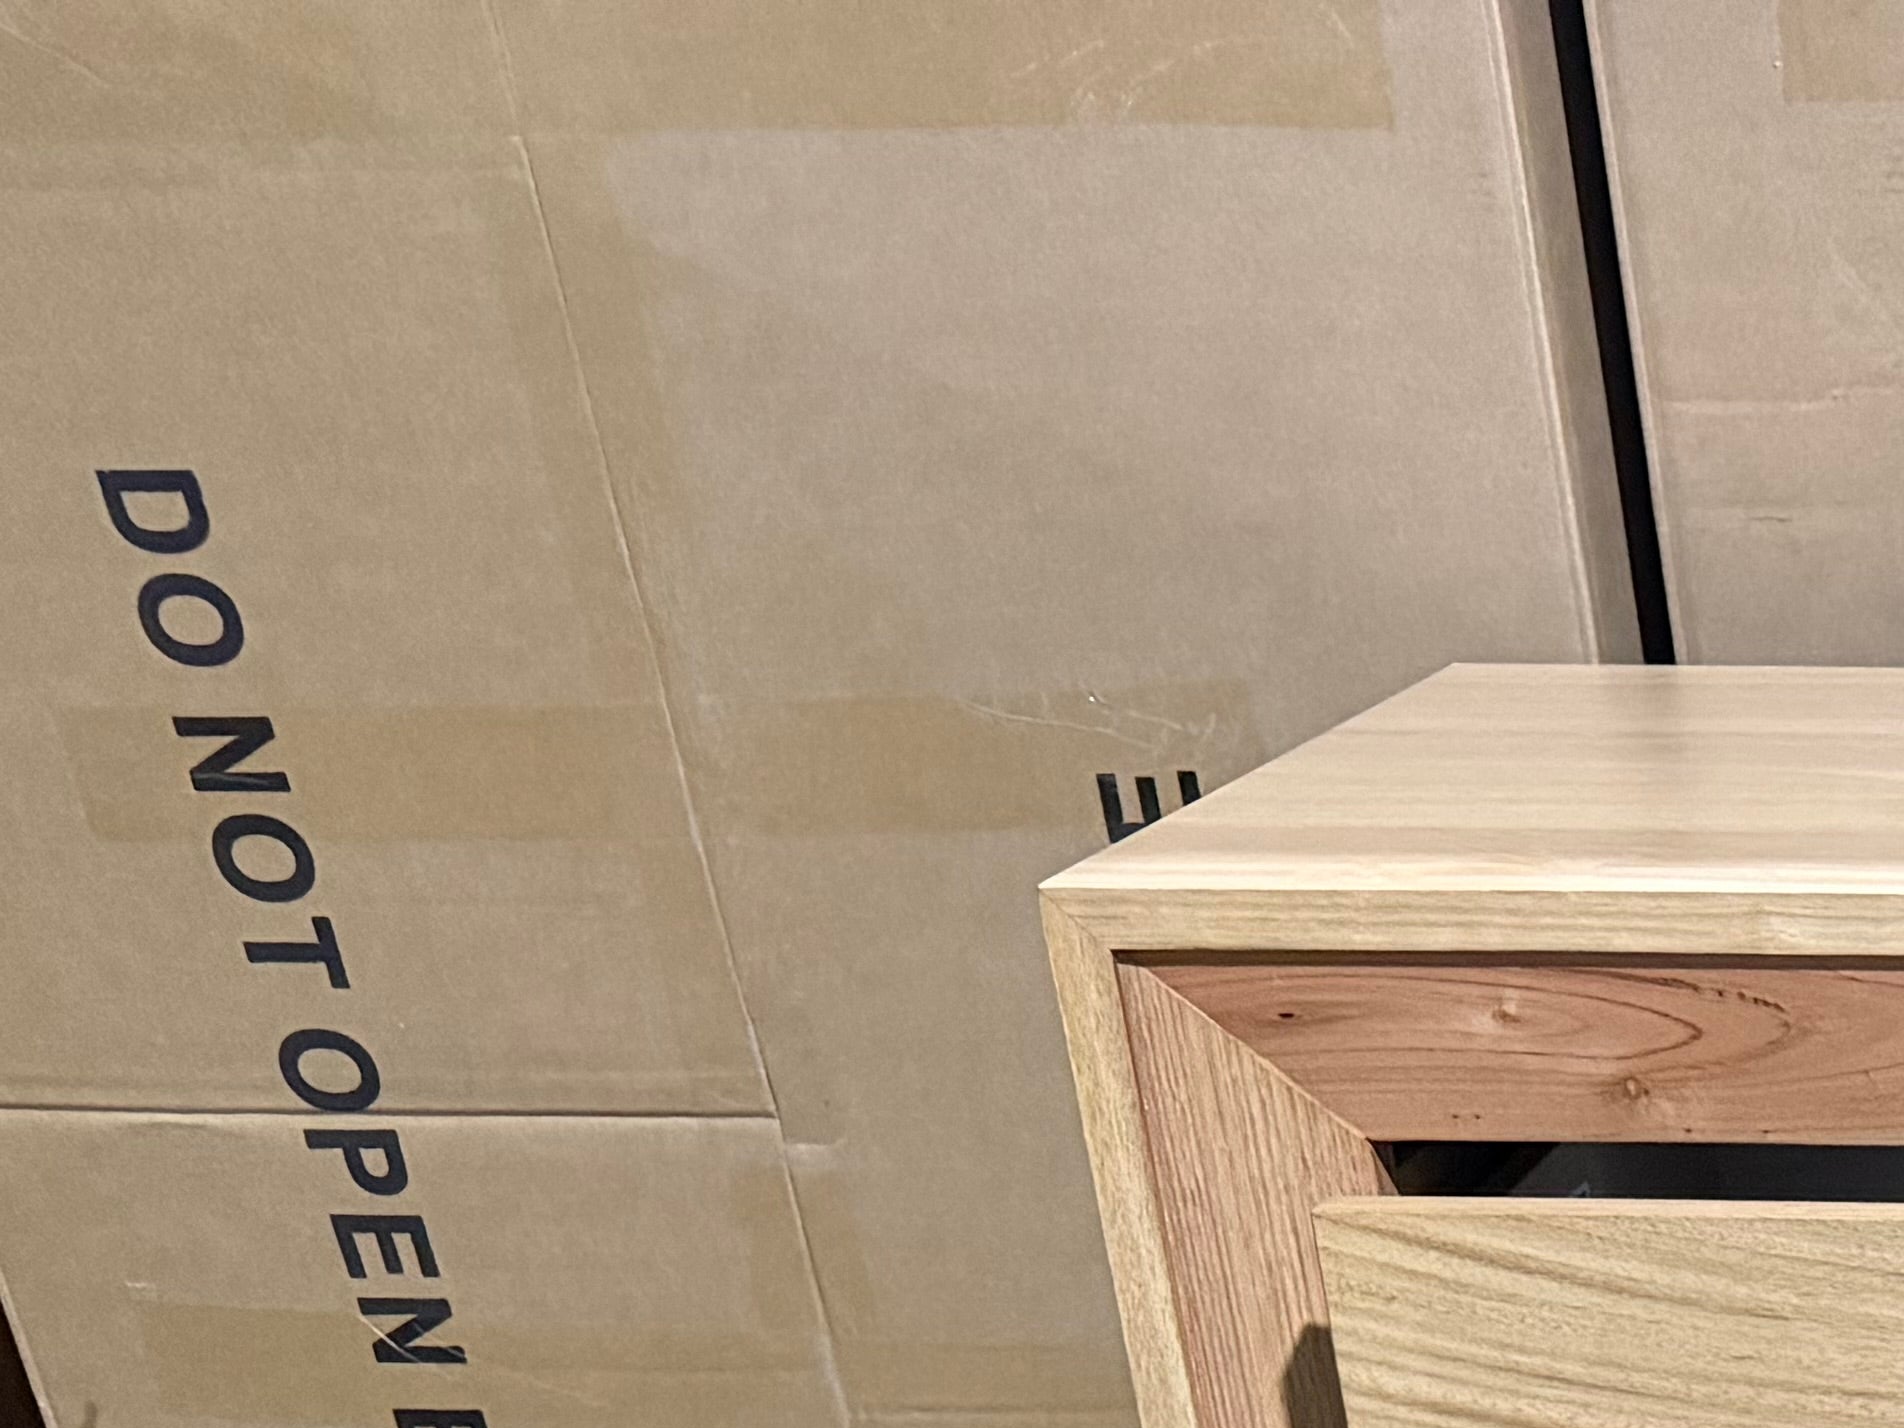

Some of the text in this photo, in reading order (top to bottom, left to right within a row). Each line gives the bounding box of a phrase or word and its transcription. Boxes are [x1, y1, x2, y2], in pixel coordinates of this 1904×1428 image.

[95, 469, 246, 668] DO
[171, 715, 352, 990] NOT
[278, 1028, 469, 1366] OPEN
